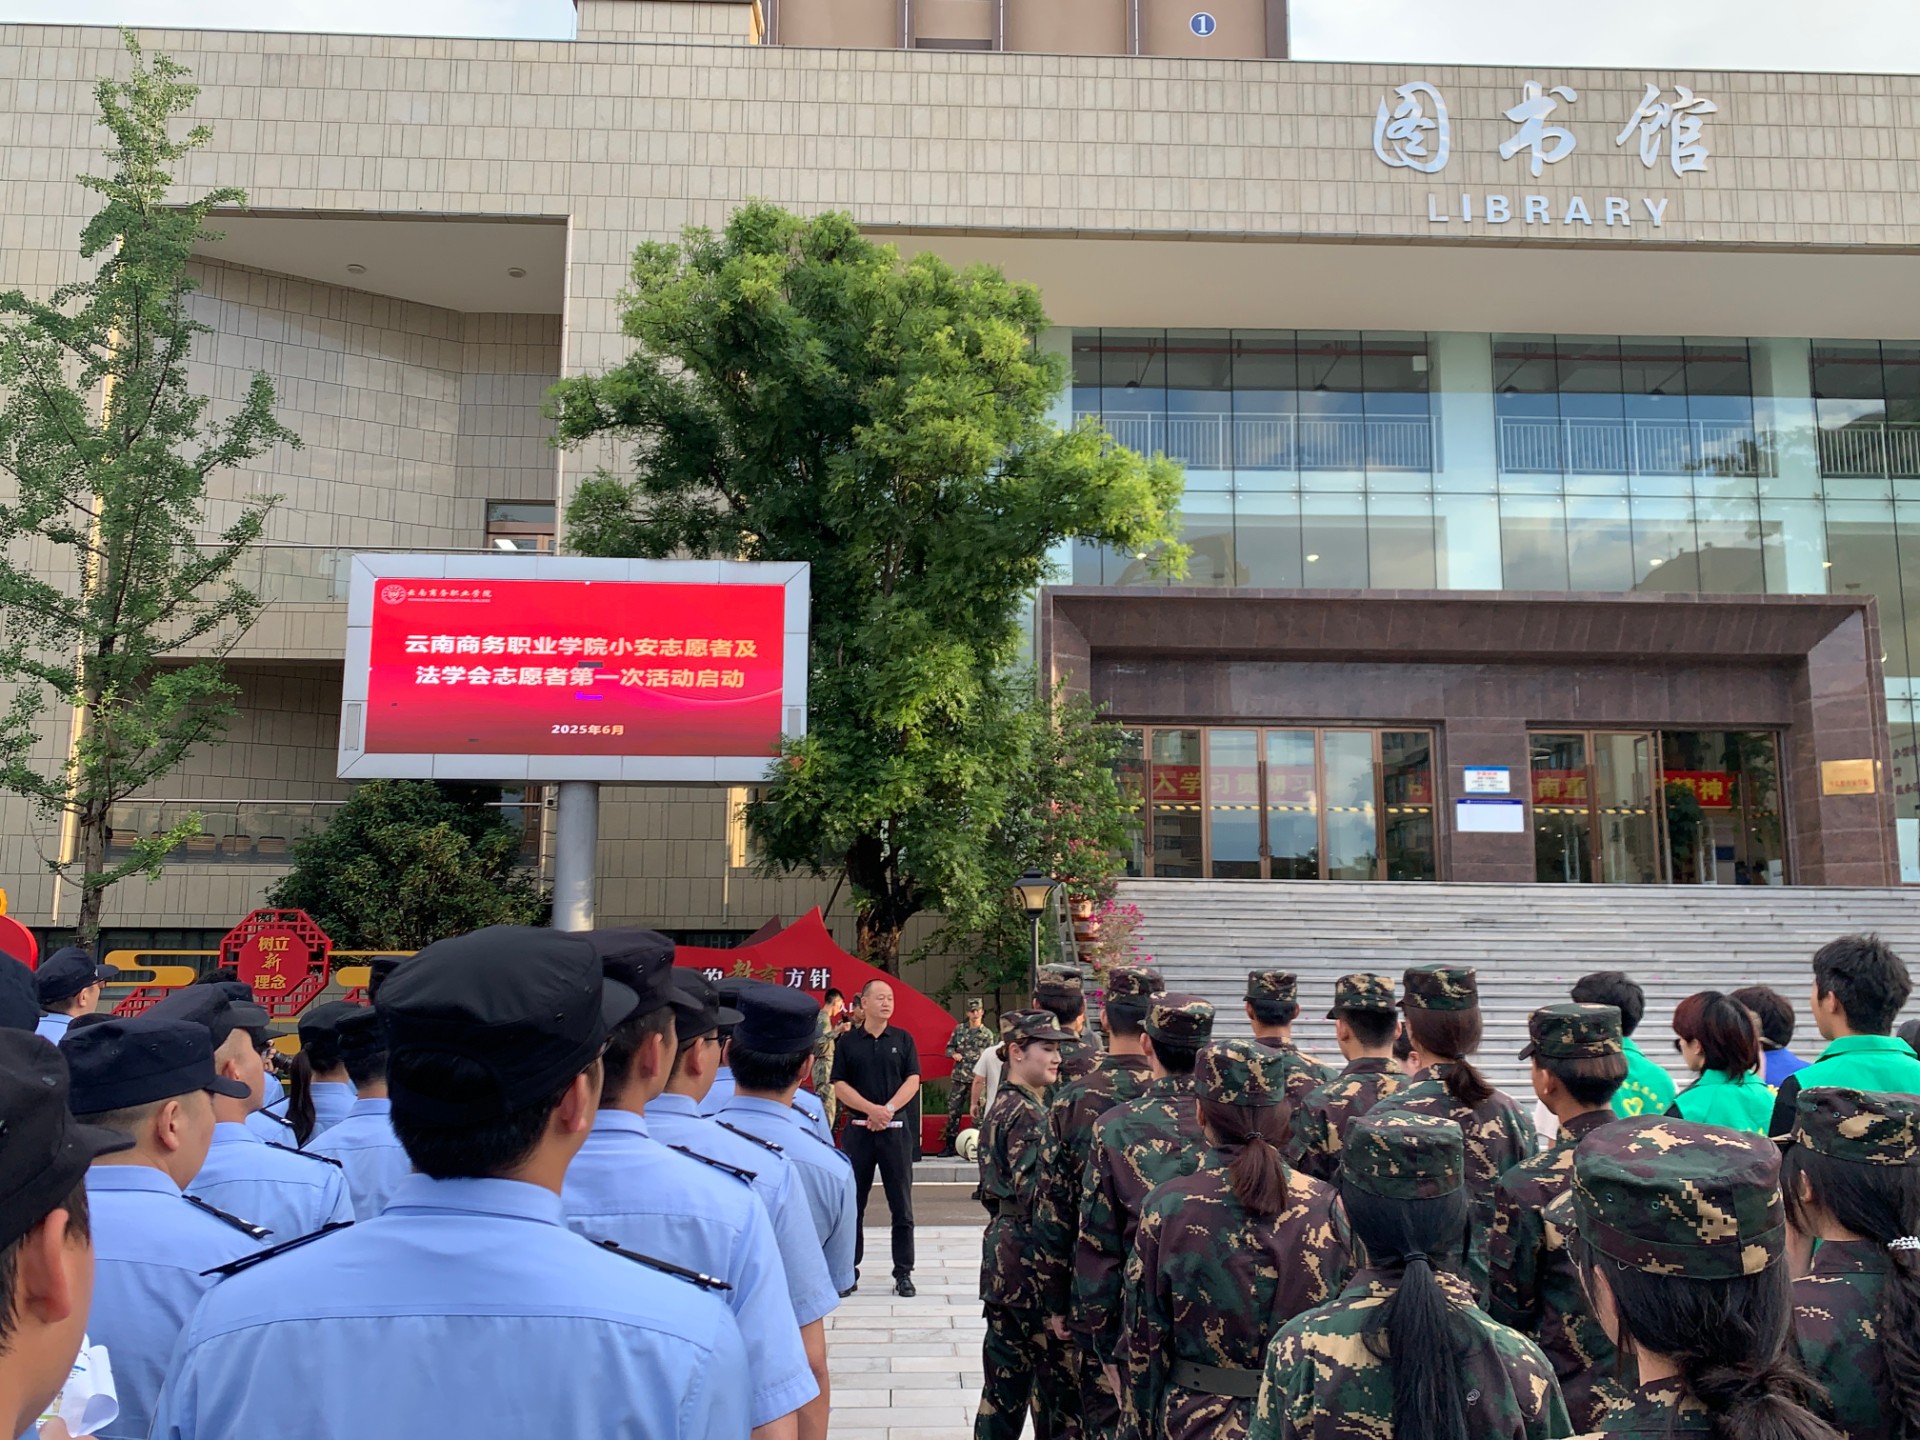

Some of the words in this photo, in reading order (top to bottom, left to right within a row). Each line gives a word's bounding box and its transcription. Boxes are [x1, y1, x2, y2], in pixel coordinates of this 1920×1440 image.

[1198, 15, 1208, 34] 1
[1373, 79, 1718, 178] 图书馆
[1428, 193, 1669, 227] LIBRARY
[405, 635, 758, 658] 云南商务职业学院小安志愿者及
[415, 665, 745, 688] 法学会志愿者第一次活动启动
[551, 724, 624, 735] 2025年6月
[258, 936, 291, 952] 树立
[261, 952, 282, 972] 新
[254, 974, 287, 989] 理念
